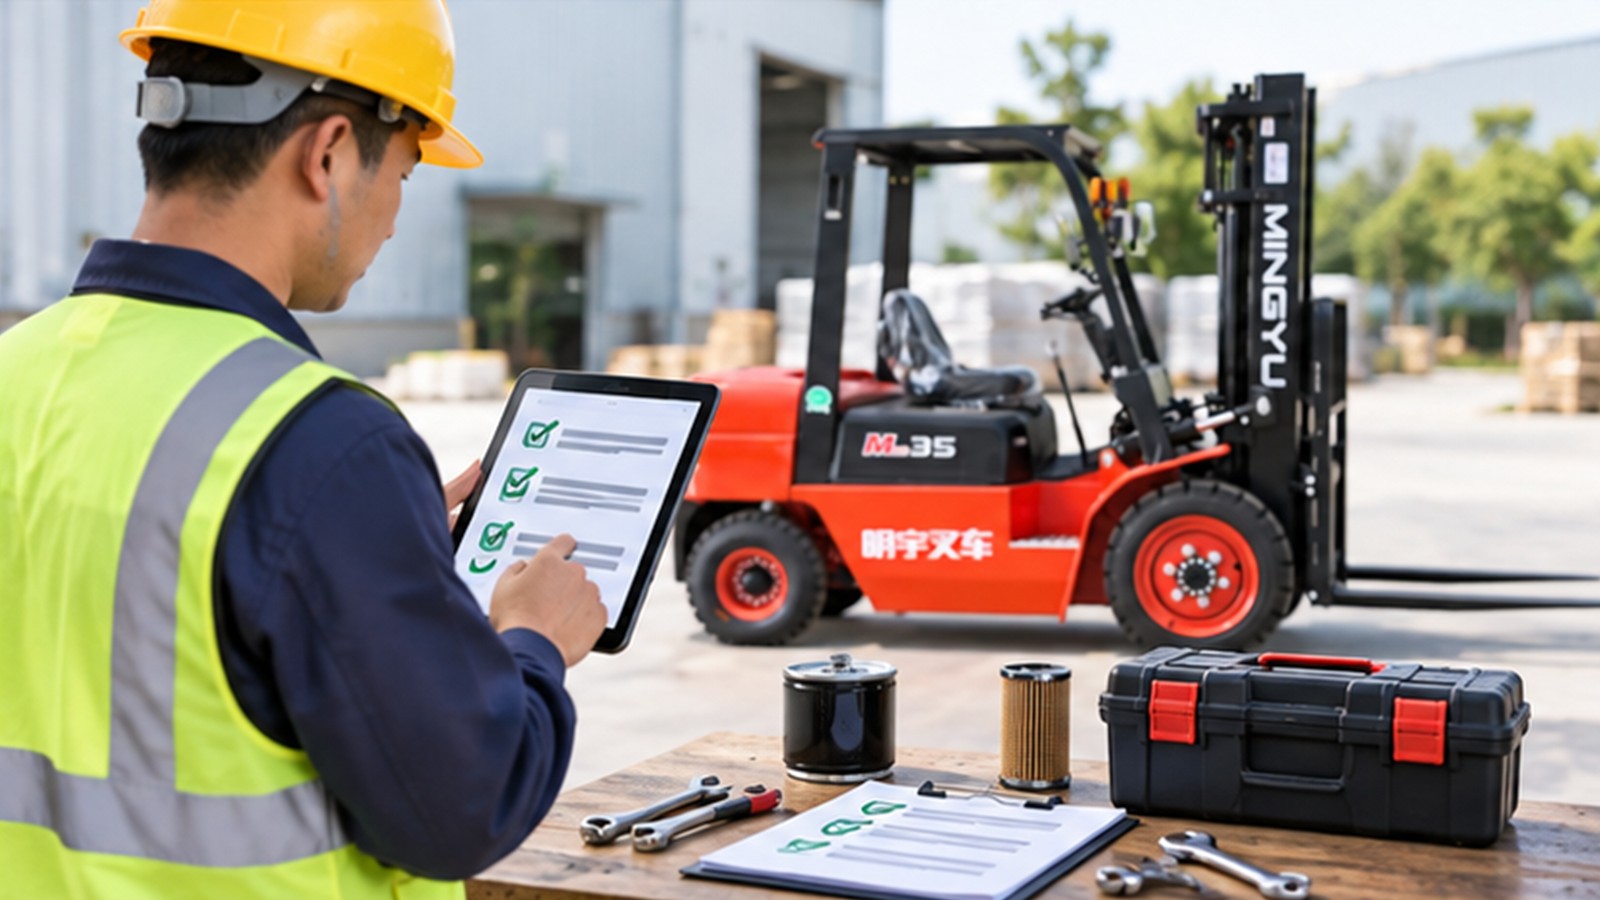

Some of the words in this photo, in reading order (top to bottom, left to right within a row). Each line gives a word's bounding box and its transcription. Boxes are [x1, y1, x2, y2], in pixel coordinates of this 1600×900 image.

[1261, 204, 1289, 388] MINGYU
[860, 527, 994, 561] 明宇叉车
